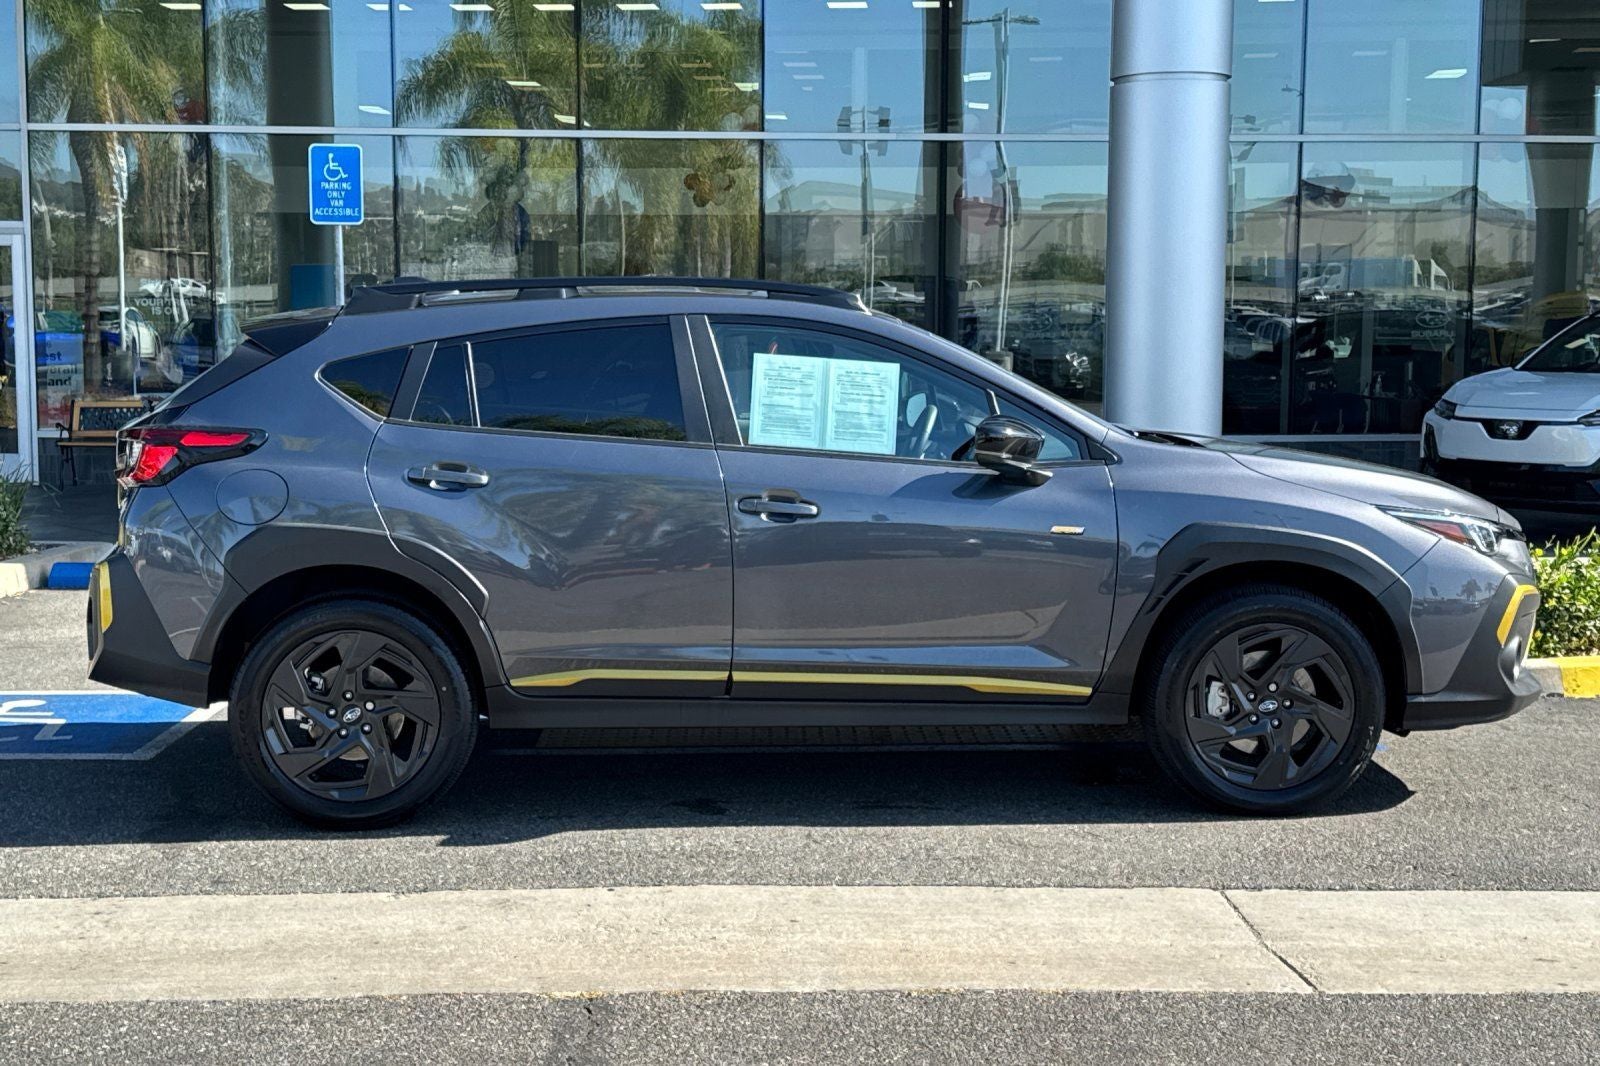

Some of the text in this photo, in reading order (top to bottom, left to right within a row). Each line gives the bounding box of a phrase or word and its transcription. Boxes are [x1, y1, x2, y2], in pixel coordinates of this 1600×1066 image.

[320, 181, 352, 190] PARKING
[327, 190, 346, 199] ONLY
[330, 199, 344, 207] VAN
[314, 207, 360, 216] ACCESSIBLE
